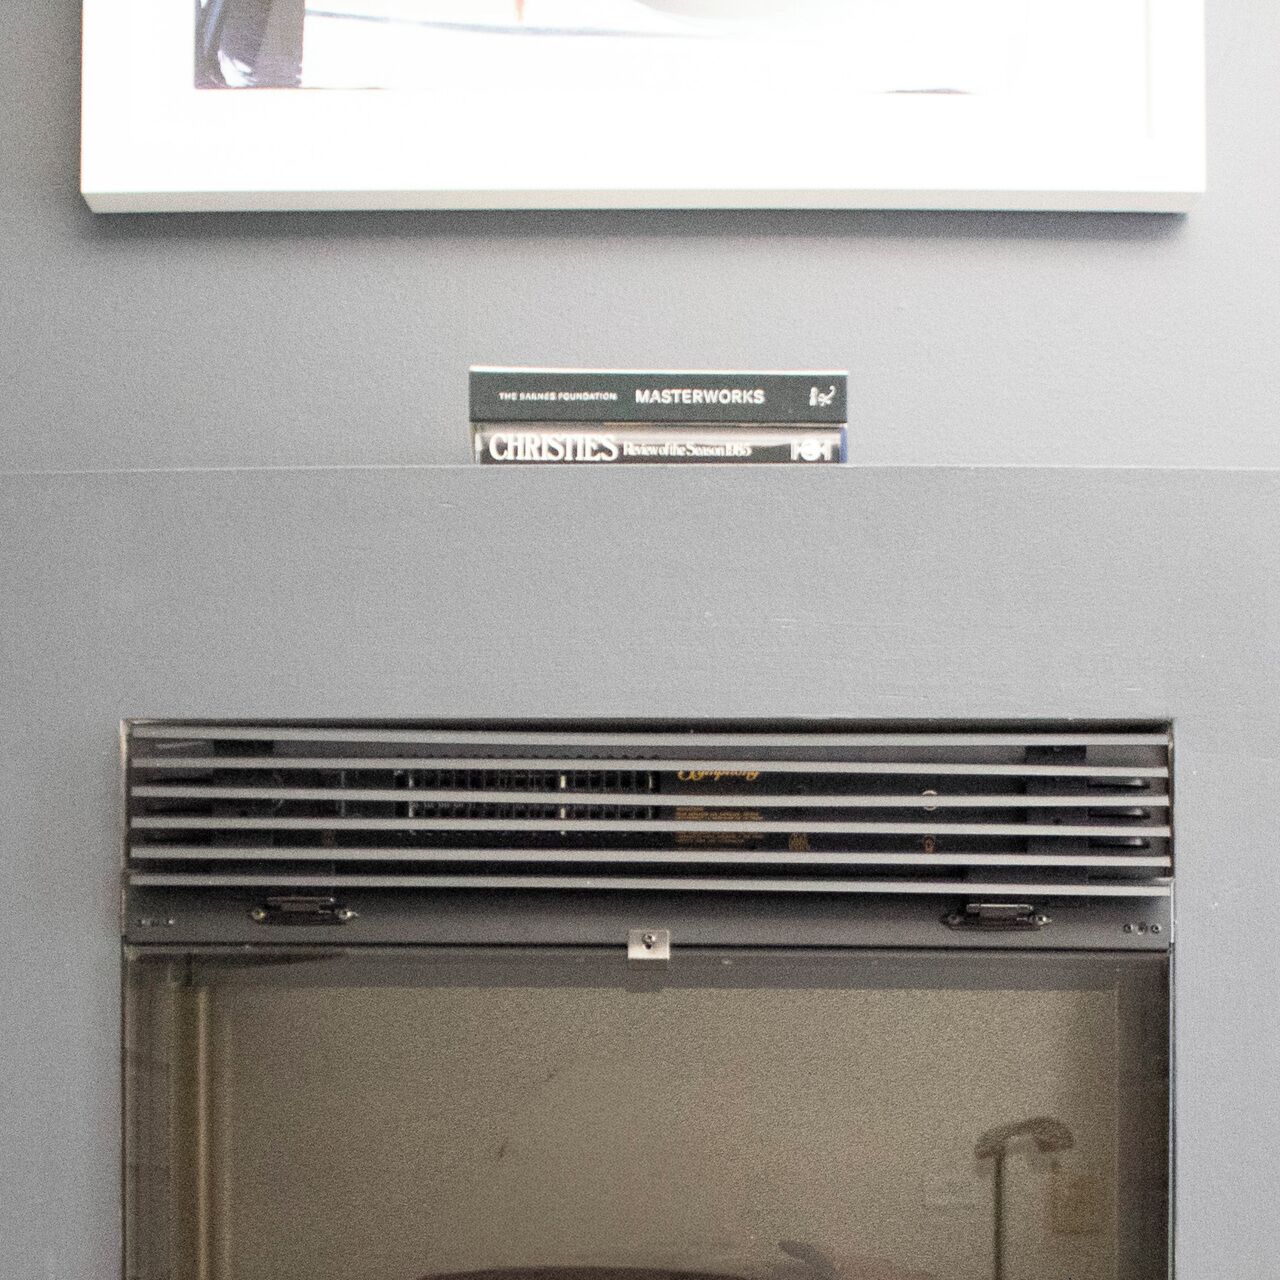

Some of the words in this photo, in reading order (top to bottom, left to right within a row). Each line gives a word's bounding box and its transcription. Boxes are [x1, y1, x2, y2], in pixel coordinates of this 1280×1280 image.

[498, 391, 517, 401] THE
[519, 391, 556, 401] BARNES
[558, 391, 618, 401] FOUNDATION
[635, 388, 766, 404] MASTERWORKS
[623, 441, 658, 456] Review
[658, 441, 669, 456] of
[669, 441, 686, 456] the
[686, 441, 724, 456] Season
